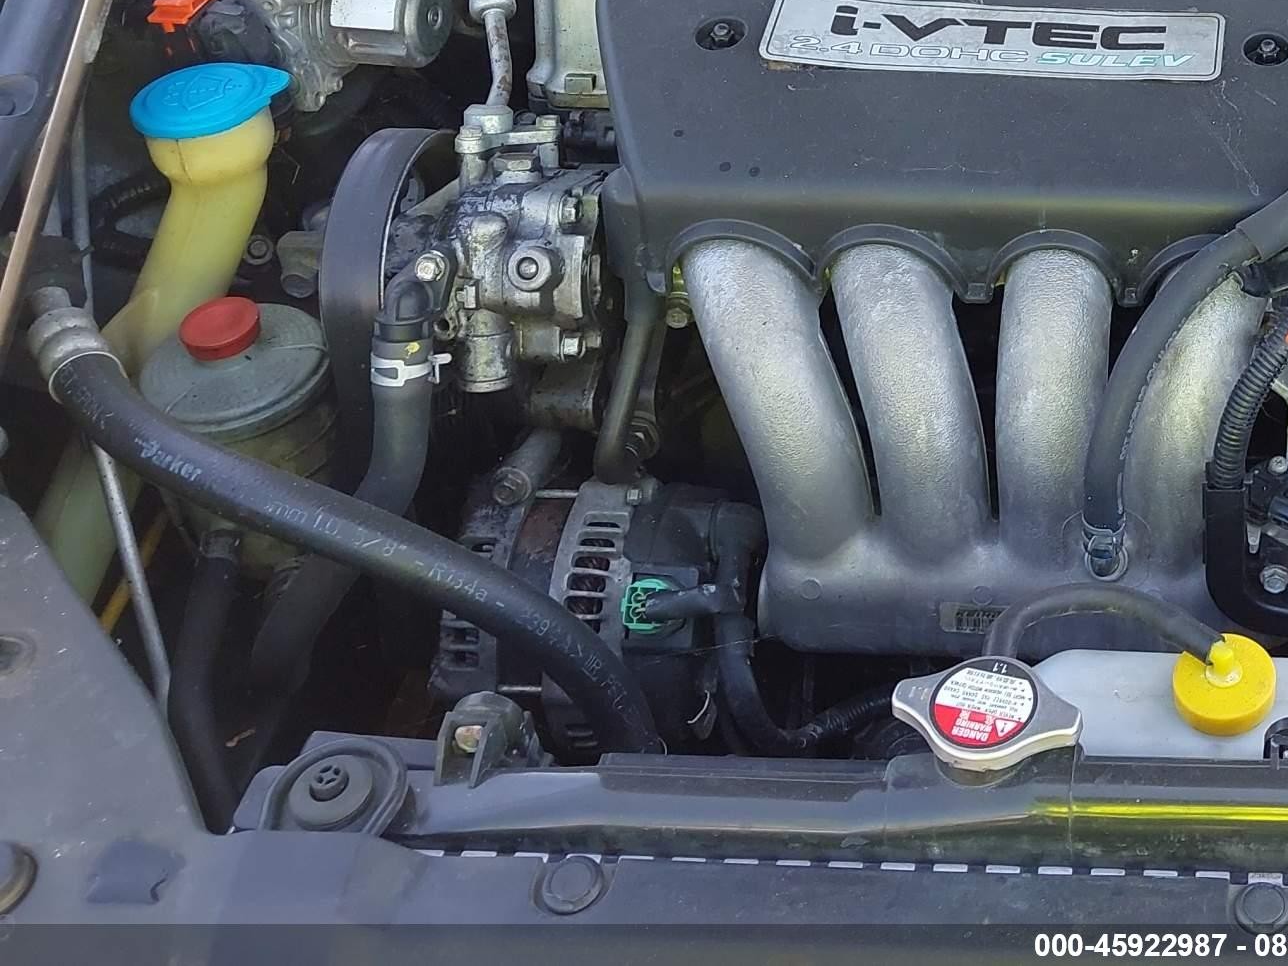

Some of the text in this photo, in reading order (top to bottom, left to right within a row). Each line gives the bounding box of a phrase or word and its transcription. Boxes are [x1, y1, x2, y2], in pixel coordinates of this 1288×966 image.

[830, 5, 1167, 51] i-VTEC
[788, 36, 1195, 68] 2.4 DOHC SULEV
[951, 726, 989, 742] DANGER
